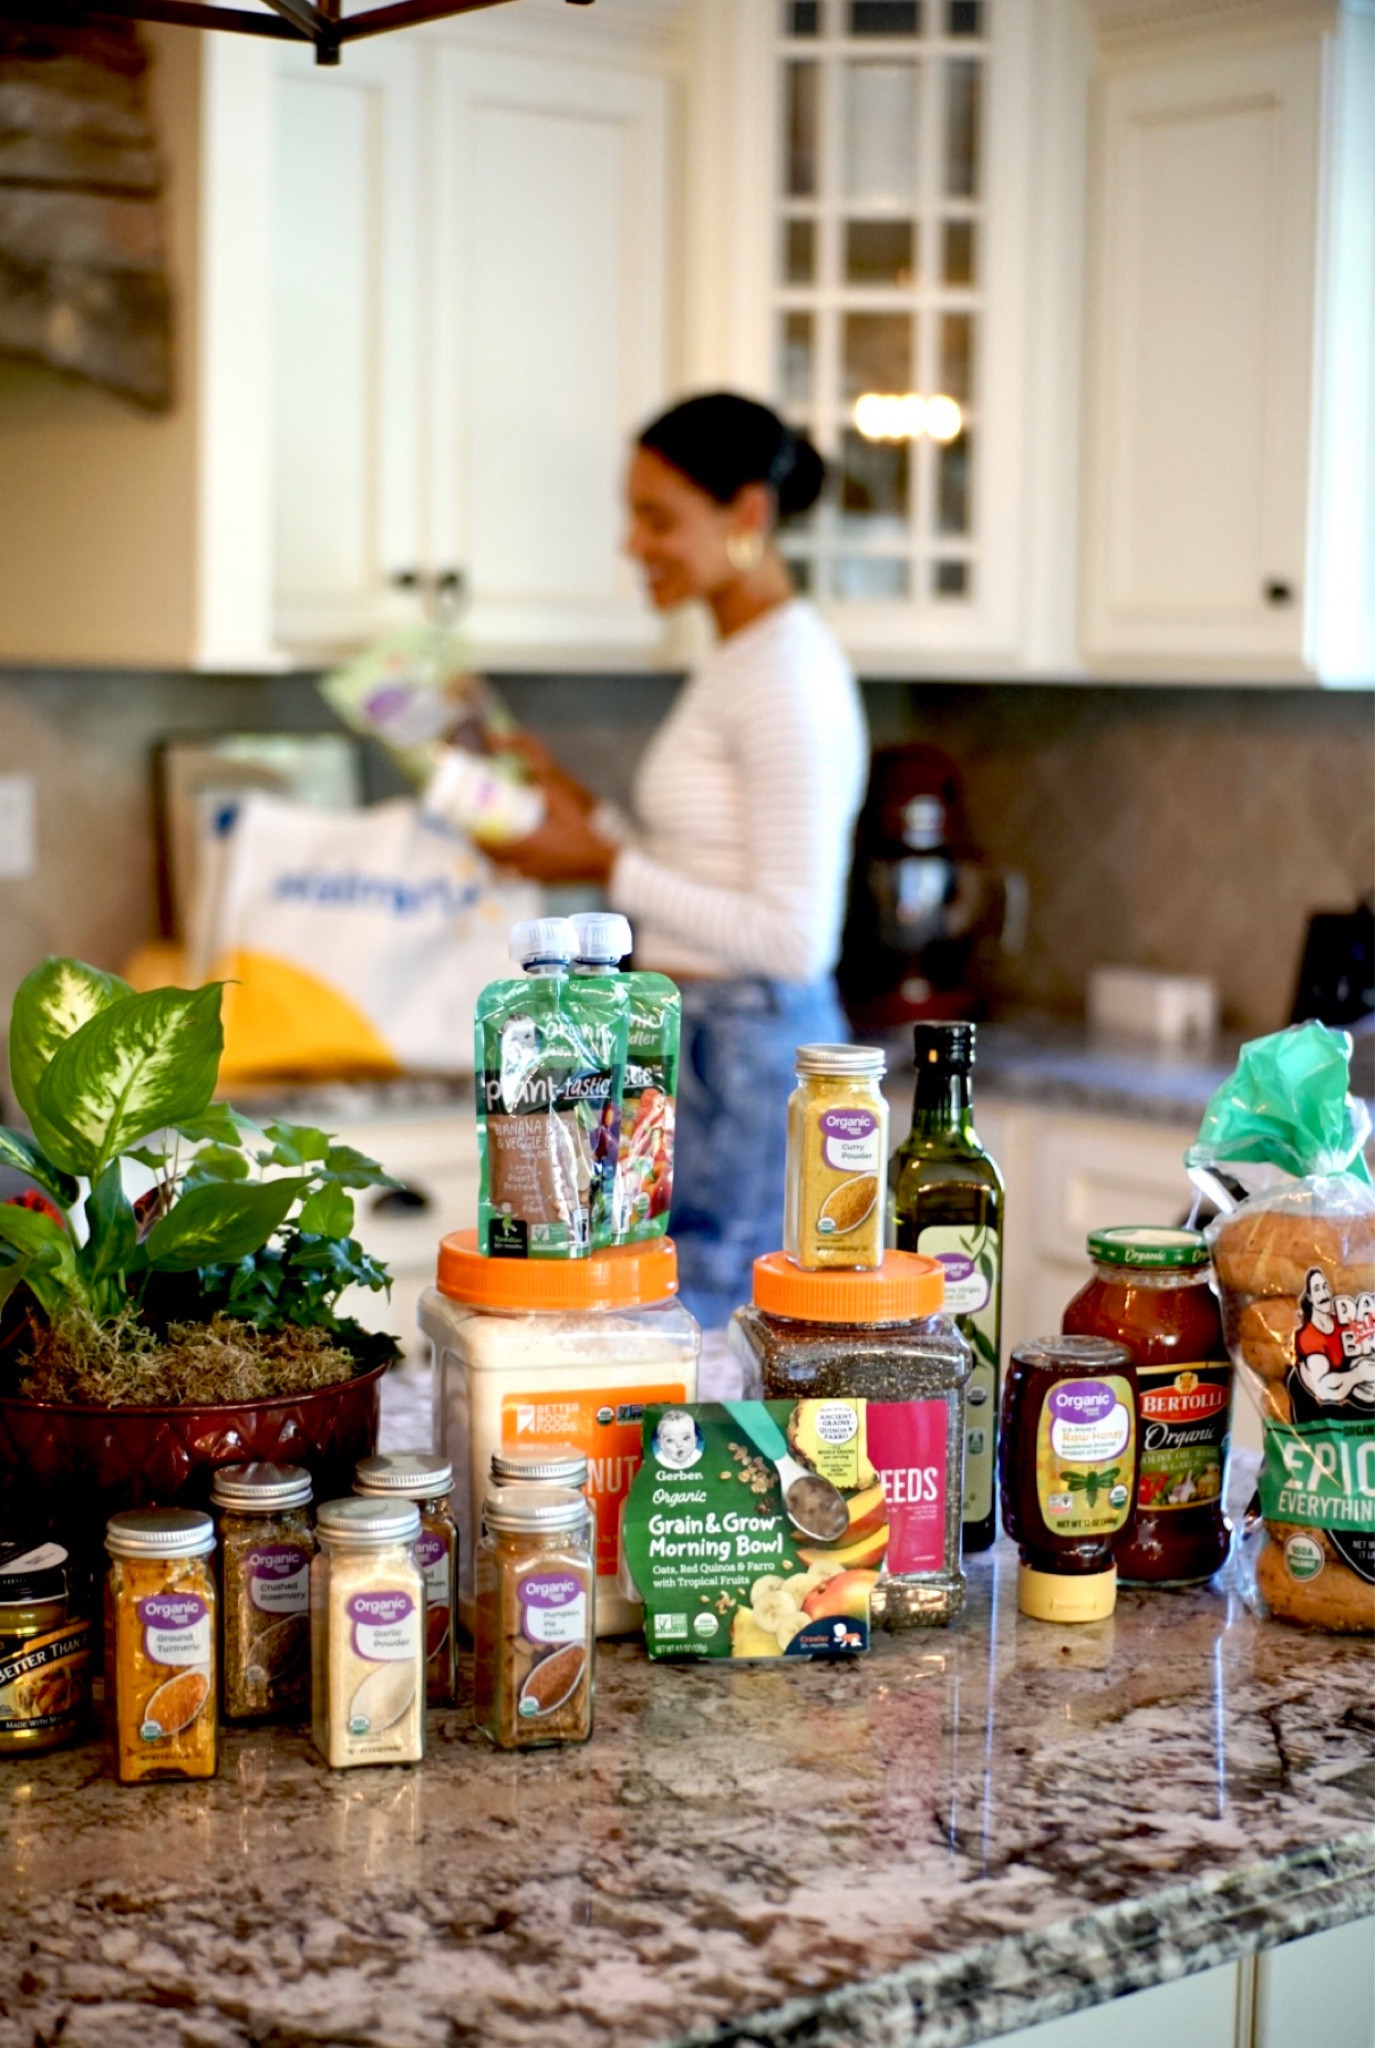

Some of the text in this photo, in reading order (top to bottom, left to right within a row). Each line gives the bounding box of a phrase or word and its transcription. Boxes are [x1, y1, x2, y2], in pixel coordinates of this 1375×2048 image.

[827, 1115, 871, 1129] Organic
[842, 1144, 864, 1152] Curry
[841, 1152, 872, 1160] Powder
[1125, 1248, 1166, 1263] Organic
[1056, 1391, 1110, 1410] Organic
[1143, 1392, 1222, 1413] BERTOLLI
[537, 1404, 580, 1413] BETTER
[1062, 1430, 1123, 1442] Raw Honey
[1144, 1422, 1216, 1451] Organic
[655, 1470, 704, 1481] Gerber
[876, 1466, 938, 1503] EEDS
[652, 1488, 707, 1507] Organic
[648, 1514, 703, 1535] Grain
[705, 1512, 721, 1533] &
[649, 1532, 783, 1561] Morning Bowl
[250, 1551, 300, 1568] Organic
[680, 1563, 698, 1574] Red
[700, 1563, 736, 1575] Quinoa
[747, 1561, 775, 1572] Farro
[260, 1582, 298, 1592] Crushed
[525, 1580, 575, 1598] Organic
[653, 1576, 750, 1590] with Tropical Fruits
[260, 1592, 306, 1601] Rosemary
[145, 1602, 199, 1618] Organic
[354, 1597, 406, 1615] Organic
[543, 1611, 580, 1619] Pumpkin
[156, 1633, 194, 1642] Ground
[374, 1630, 402, 1638] Garlic
[543, 1629, 565, 1637] Spice
[157, 1643, 200, 1653] Turmeric
[374, 1639, 410, 1648] Powder
